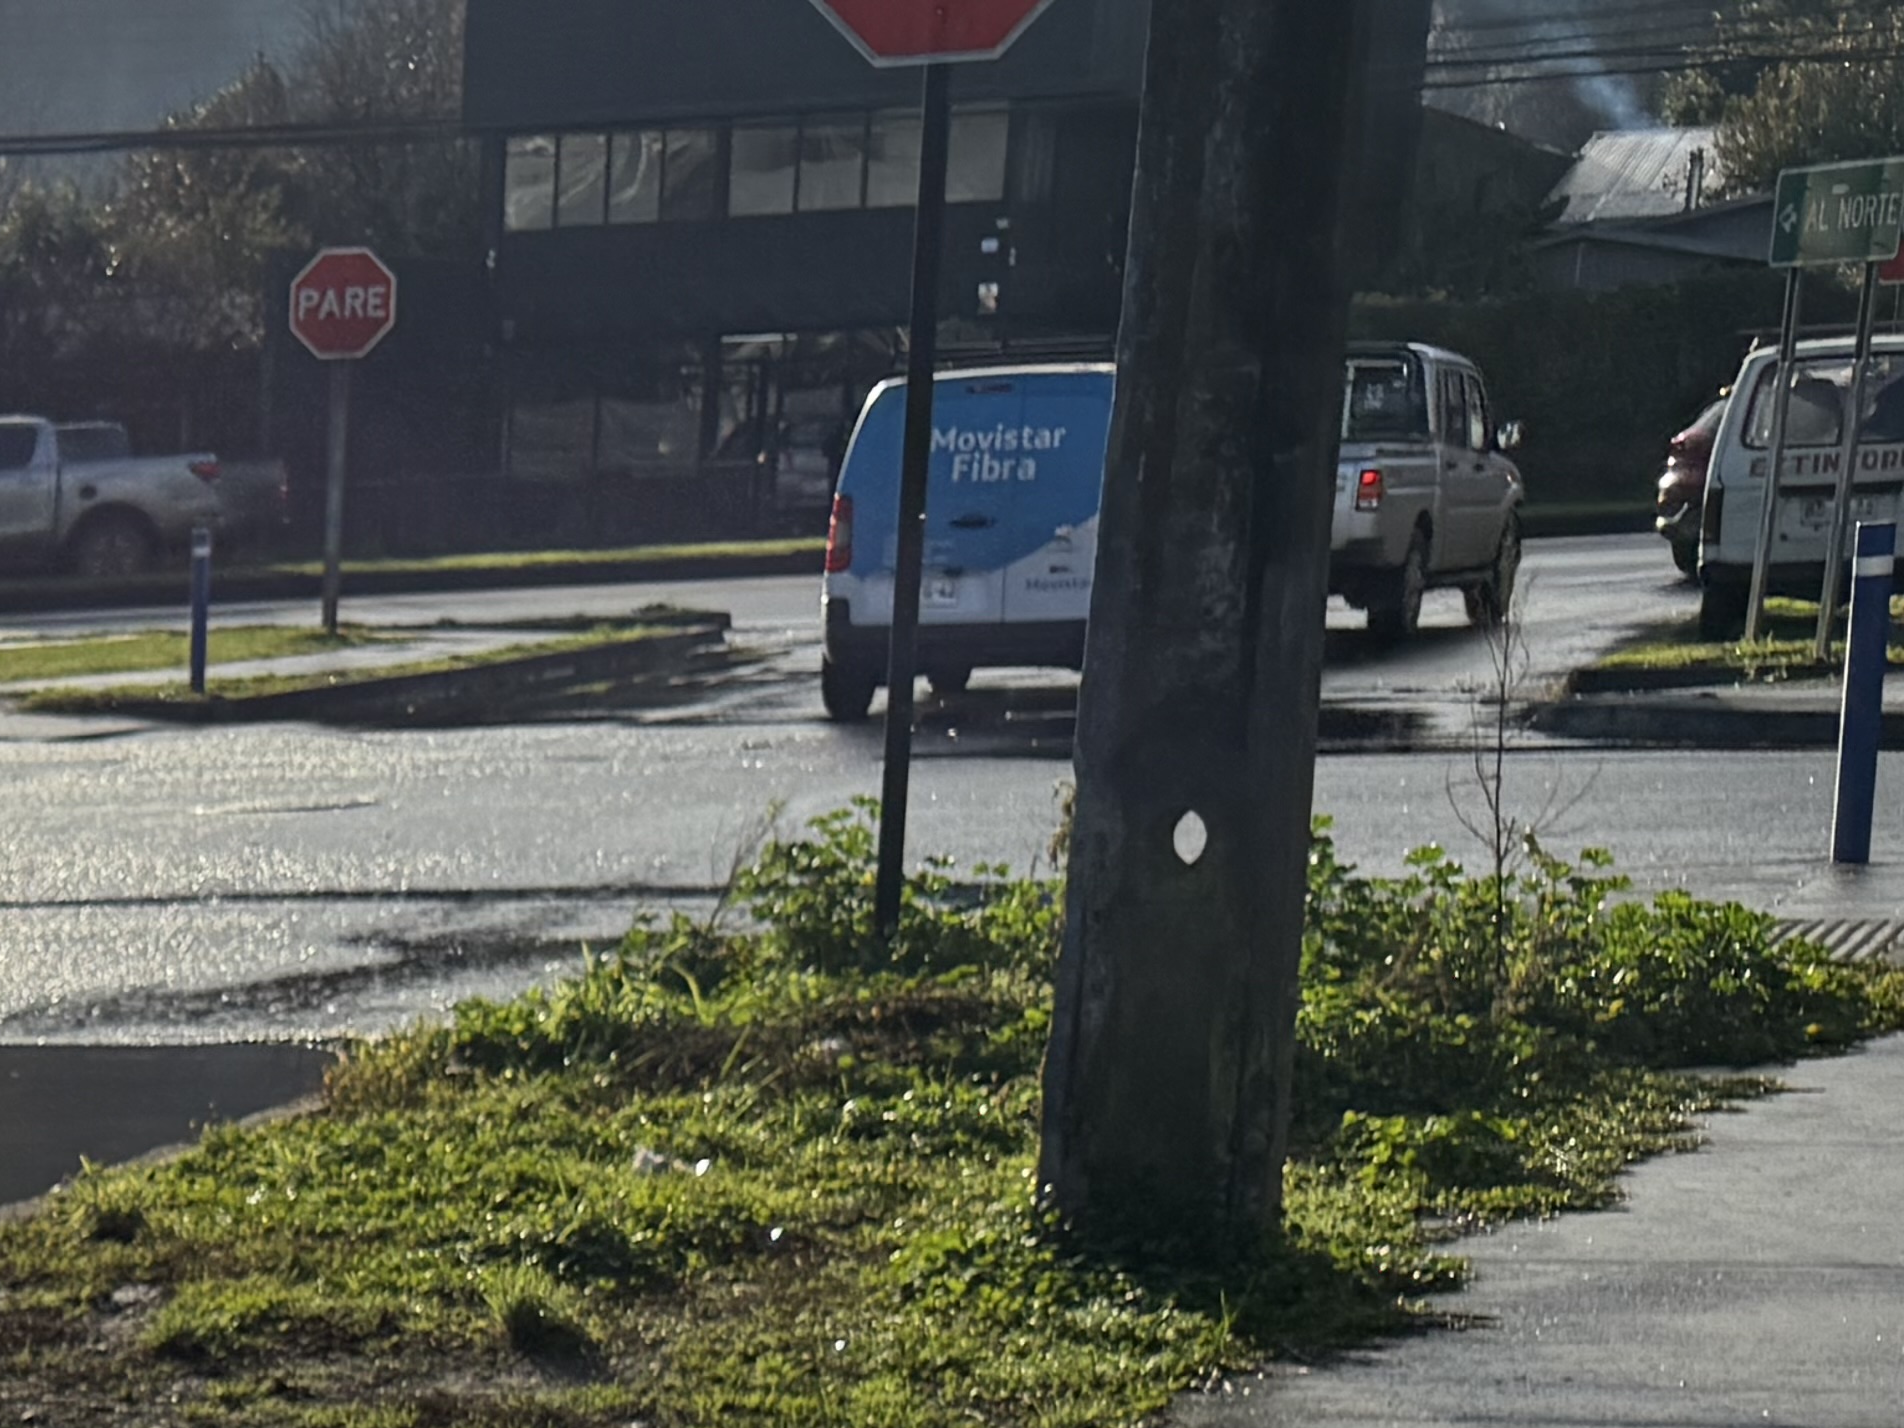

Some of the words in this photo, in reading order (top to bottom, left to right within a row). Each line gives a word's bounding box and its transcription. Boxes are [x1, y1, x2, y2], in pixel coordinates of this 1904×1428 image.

[1805, 198, 1829, 232] AL
[1838, 192, 1901, 230] NORTE
[298, 285, 388, 321] PARE
[930, 422, 1067, 453] Movistar
[950, 452, 1037, 483] Fibra
